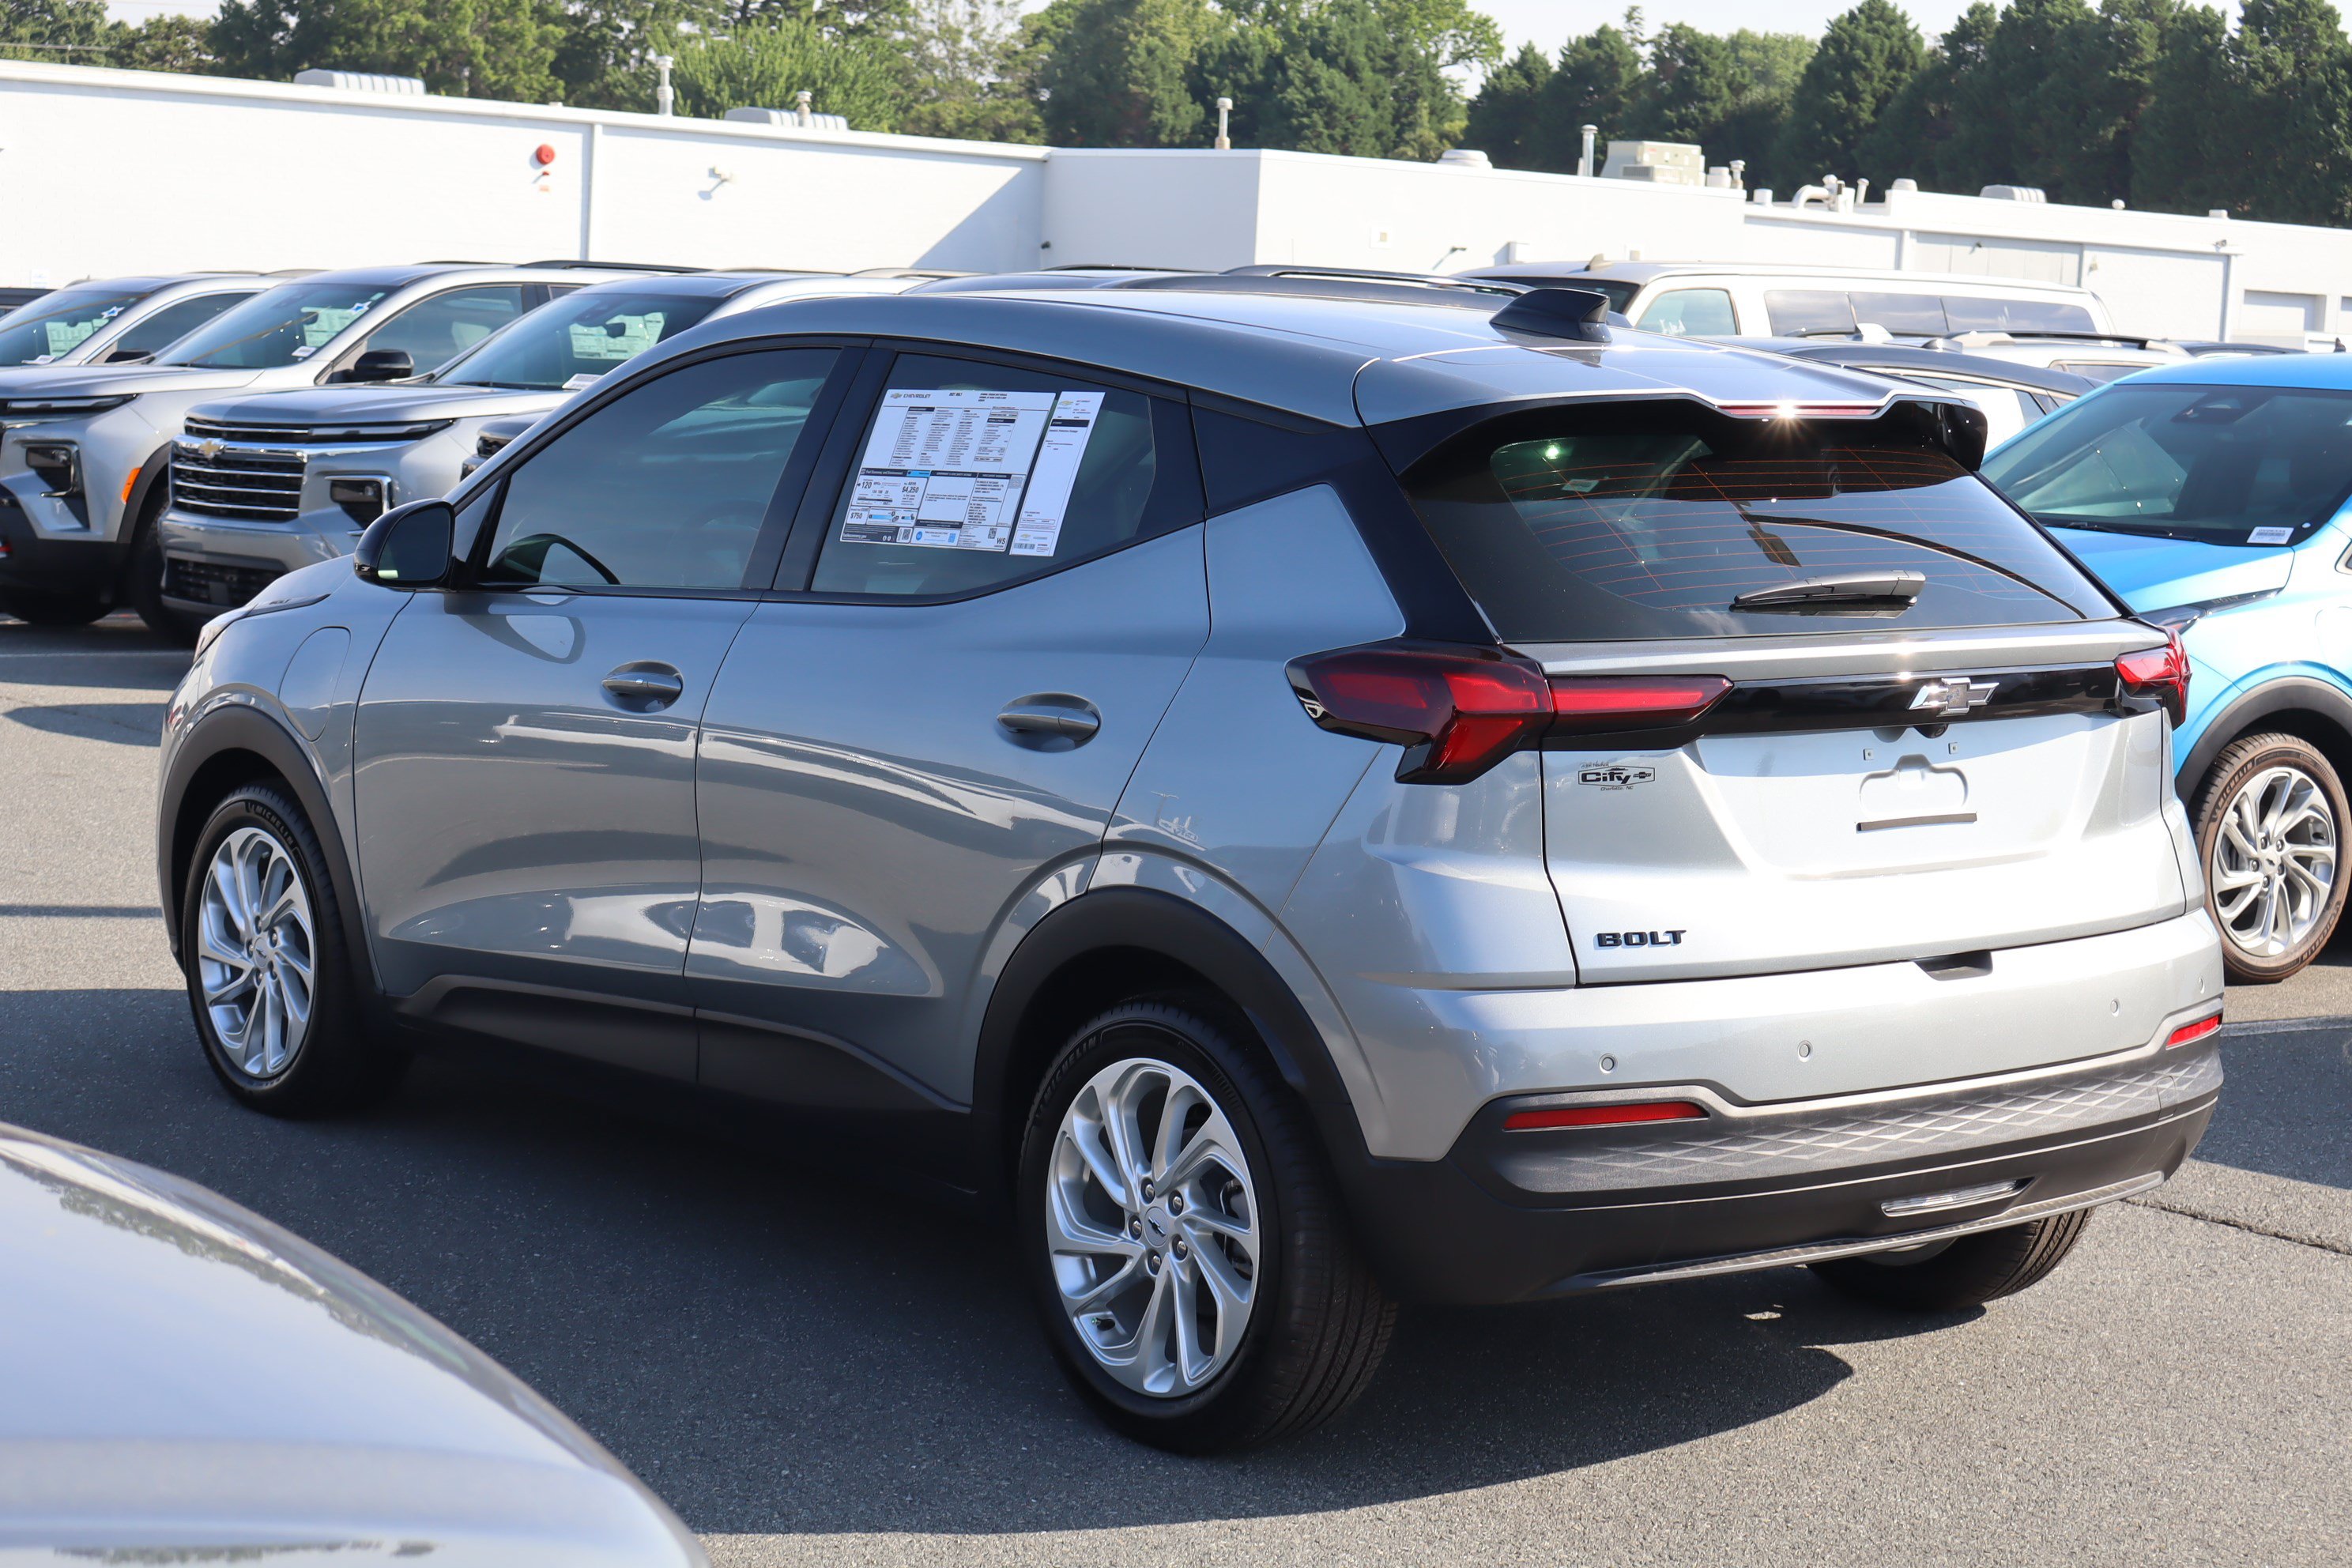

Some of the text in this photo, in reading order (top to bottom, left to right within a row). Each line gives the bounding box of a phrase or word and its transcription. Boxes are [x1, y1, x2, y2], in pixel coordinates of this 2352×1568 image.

[1581, 771, 1631, 784] City
[2218, 760, 2252, 807] MICHELIN
[255, 805, 293, 846] MICHELIN
[1596, 929, 1687, 947] BOLT
[1044, 1035, 1097, 1100] MICHELIN
